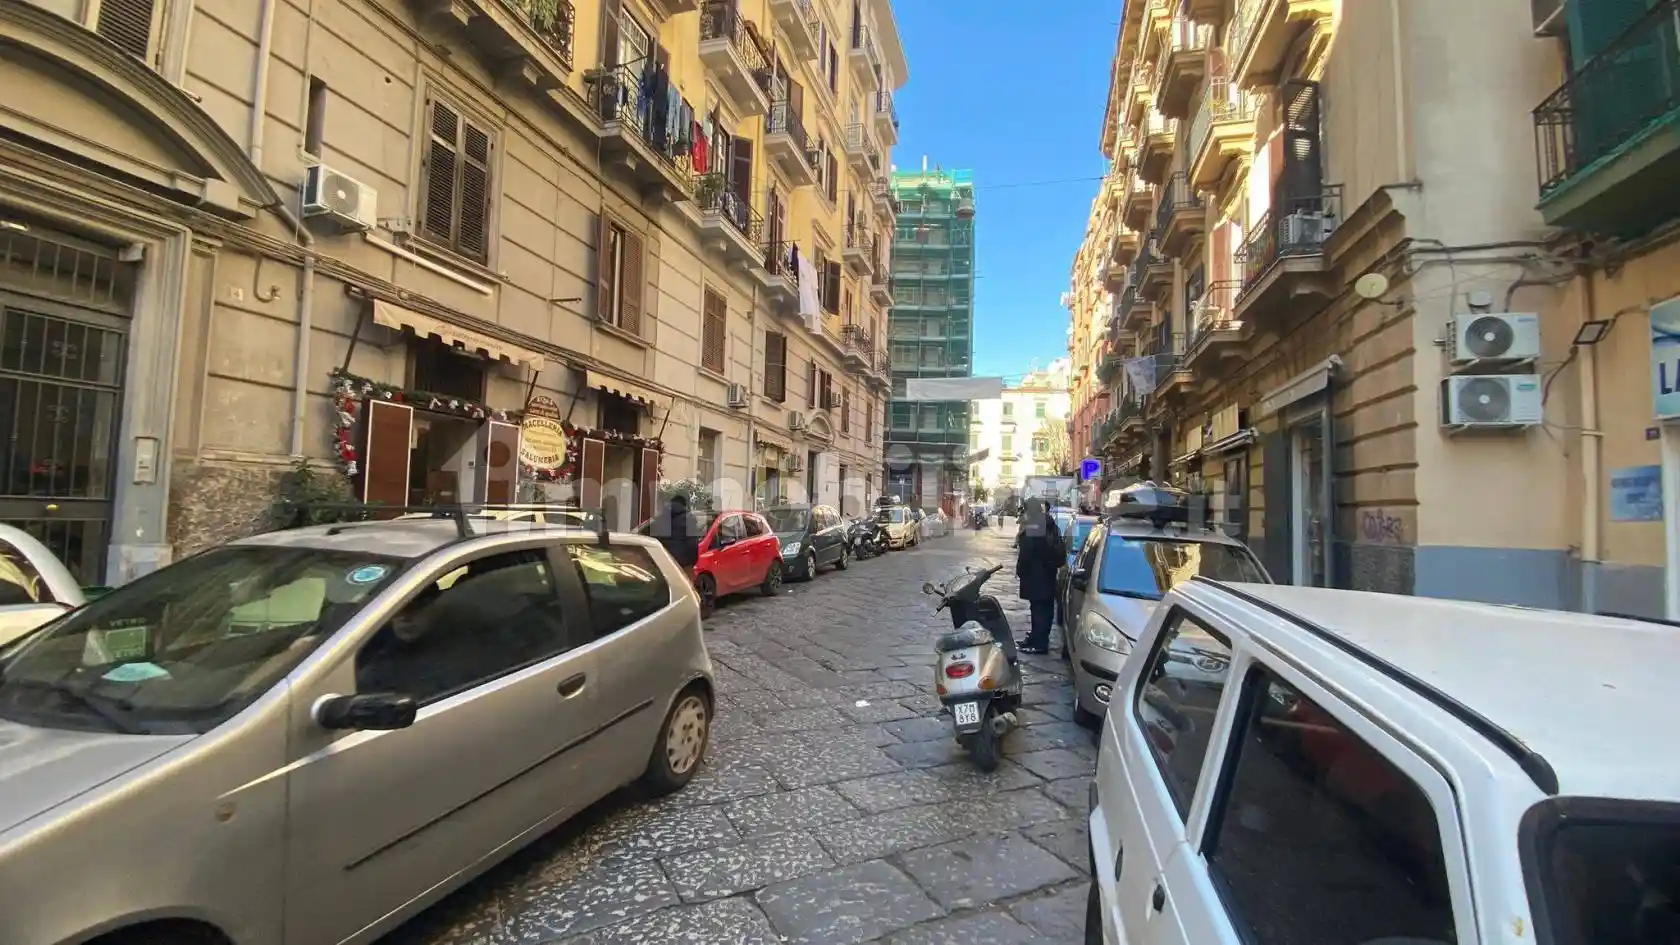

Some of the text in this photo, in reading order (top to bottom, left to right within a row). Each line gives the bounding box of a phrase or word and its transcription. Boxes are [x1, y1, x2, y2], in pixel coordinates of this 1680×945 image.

[1659, 358, 1680, 395] L
[522, 419, 563, 437] MACELLERIA
[520, 447, 559, 463] SALUMERIA
[1083, 460, 1100, 480] P
